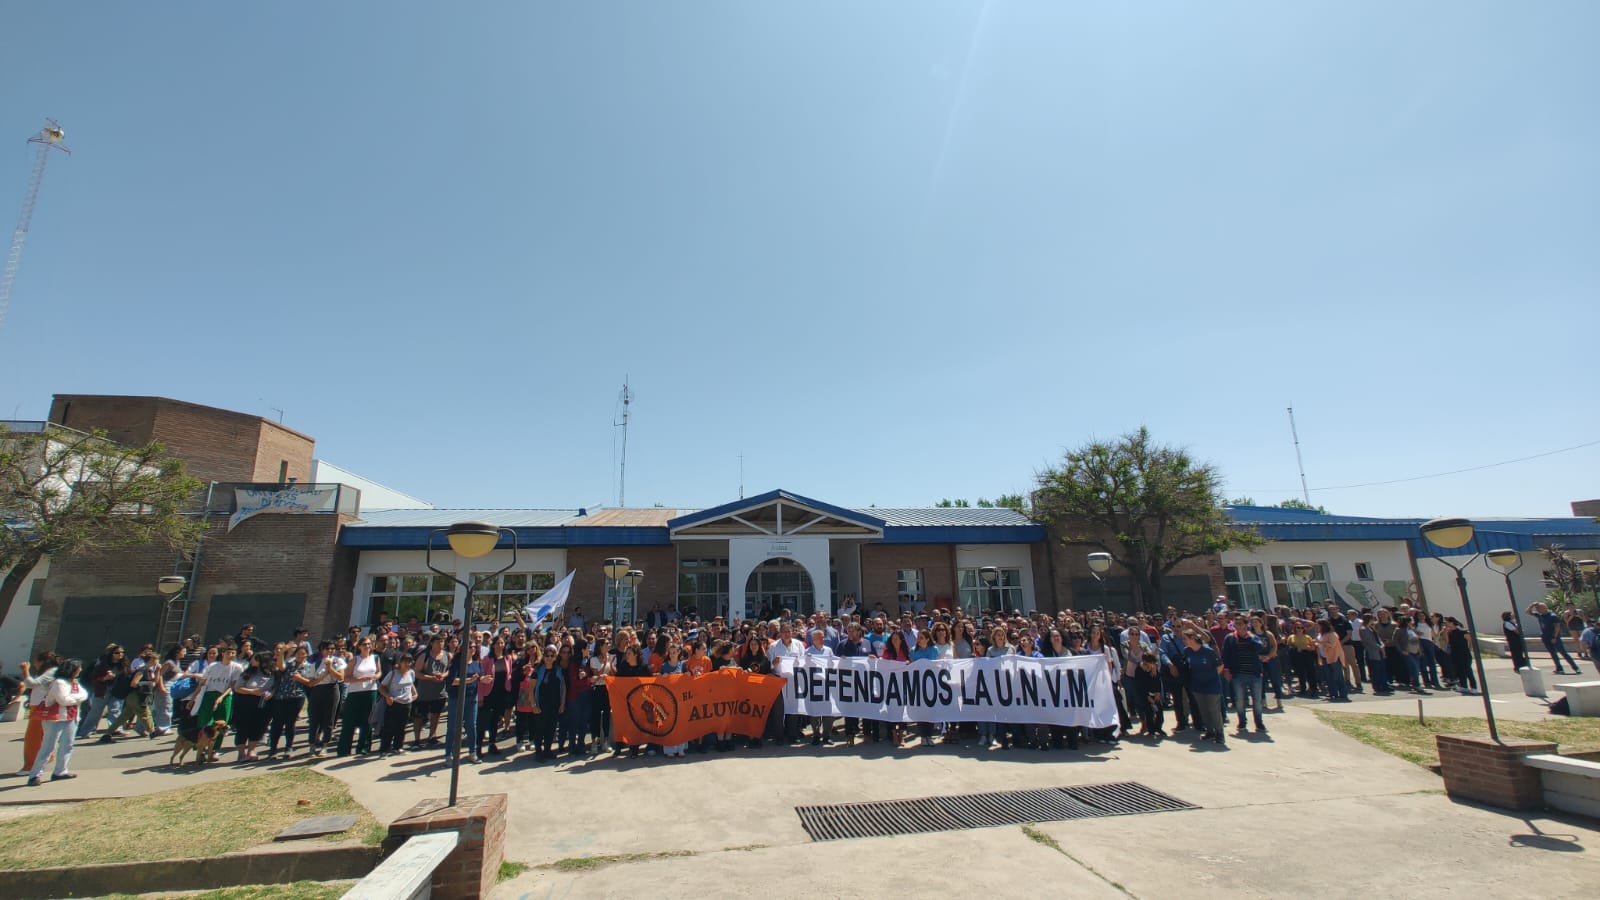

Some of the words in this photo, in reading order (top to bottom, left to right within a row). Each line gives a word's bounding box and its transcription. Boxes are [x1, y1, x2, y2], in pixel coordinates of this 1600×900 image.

[682, 691, 694, 701] EL
[793, 667, 953, 707] DEFENDAMOS
[960, 669, 993, 706] LA
[994, 669, 1095, 708] U.N.V.M.
[688, 699, 766, 722] ALUVIÓN
